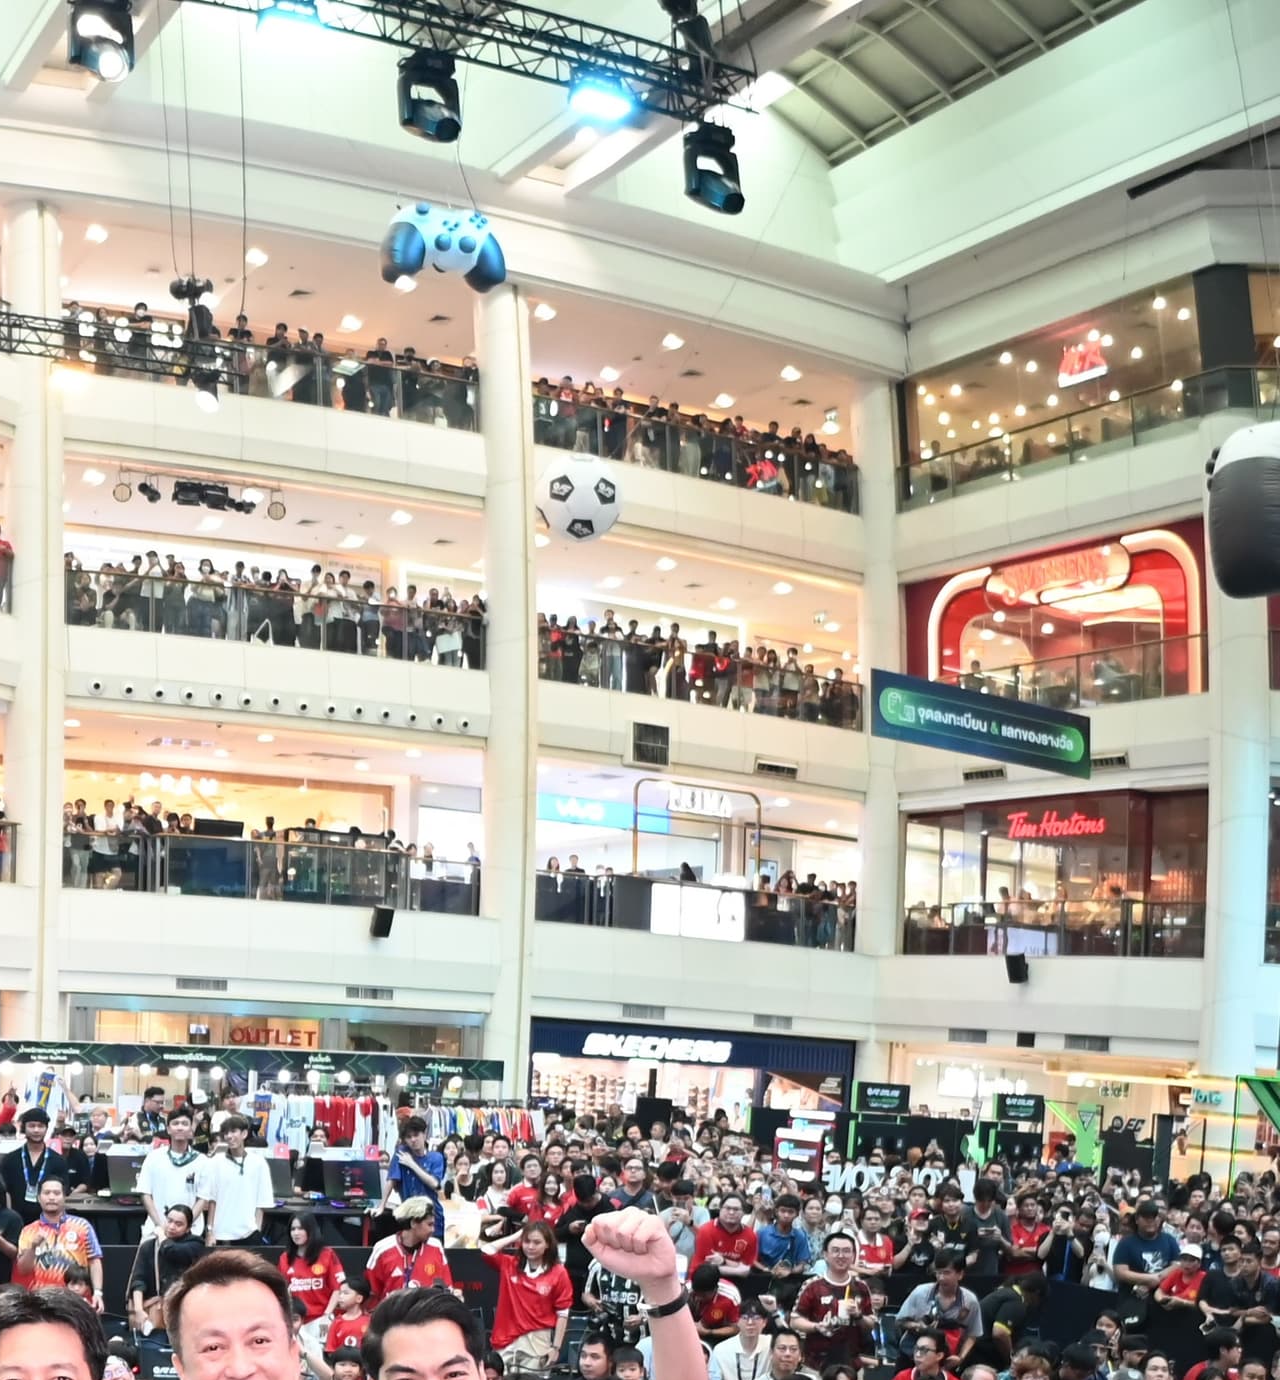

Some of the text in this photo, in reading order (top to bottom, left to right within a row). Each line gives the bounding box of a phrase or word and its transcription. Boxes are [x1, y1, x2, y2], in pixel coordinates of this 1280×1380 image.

[1007, 810, 1106, 838] Tim Hortons
[229, 1026, 317, 1047] OUTLET
[582, 1032, 732, 1063] SKECHERS
